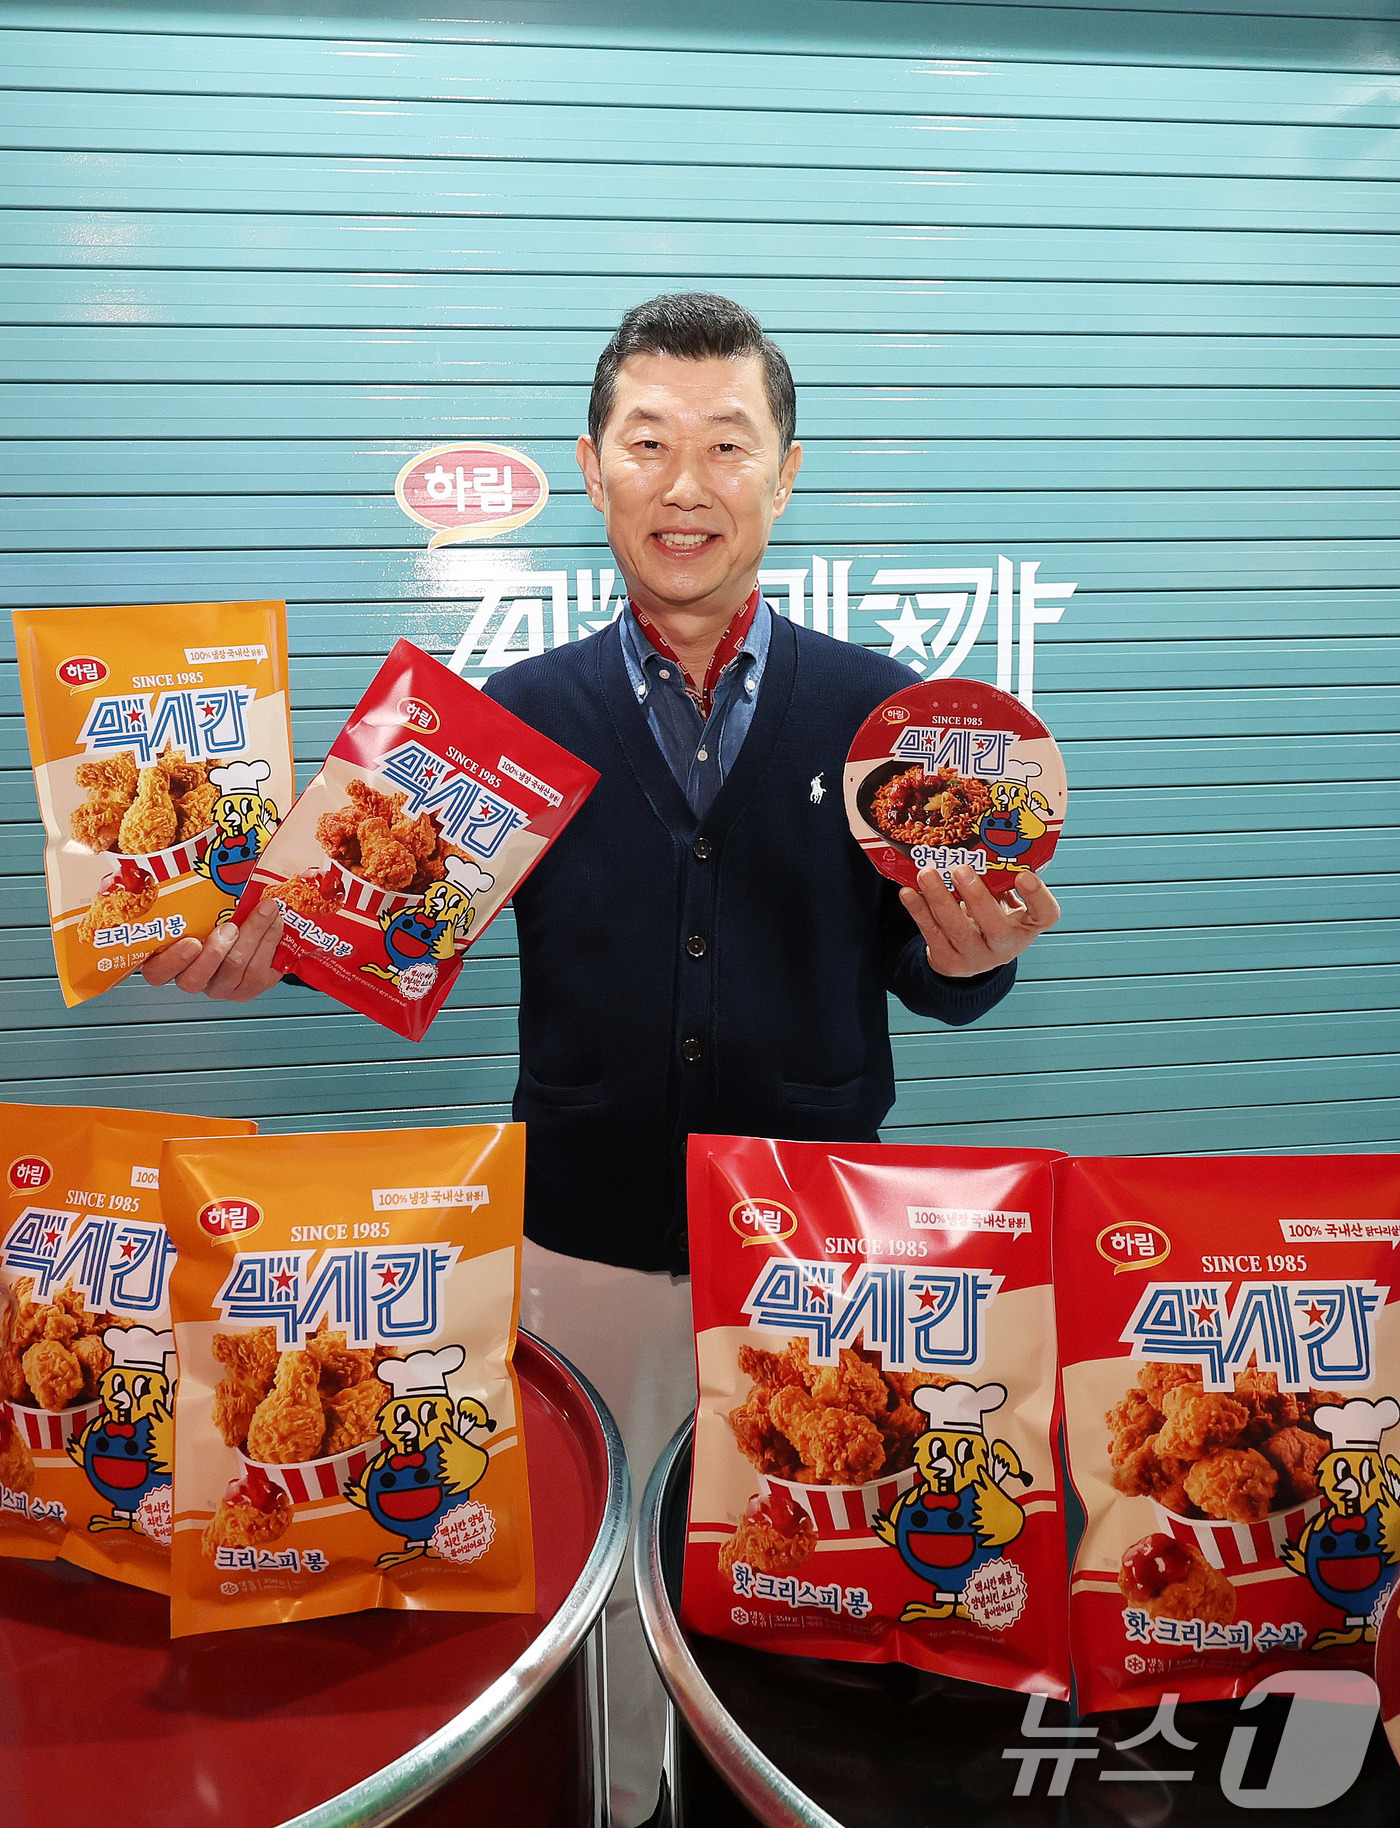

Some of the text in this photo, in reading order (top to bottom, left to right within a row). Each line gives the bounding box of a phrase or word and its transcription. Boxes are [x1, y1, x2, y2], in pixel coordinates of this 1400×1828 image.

[424, 465, 513, 513] 하림
[190, 651, 211, 661] 100%
[227, 647, 250, 658] 국내산
[66, 663, 99, 681] 하림
[132, 672, 204, 689] SINCE 1985
[86, 688, 250, 762] 맥시칸
[406, 702, 433, 729] 하림
[887, 710, 904, 720] 하림
[932, 715, 983, 726] SINCE 1985
[896, 730, 1014, 775] 맥시칸
[445, 746, 503, 788] SINCE 1985
[501, 761, 519, 776] 100%
[381, 745, 524, 859] 맥시칸
[913, 847, 984, 872] 양념치킨
[95, 916, 185, 946] 크리스피 봉
[286, 911, 337, 951] 크리스피
[335, 943, 352, 958] 봉
[16, 1163, 45, 1185] 하림
[66, 1190, 141, 1213] SINCE 1985
[378, 1193, 408, 1206] 100%
[409, 1192, 429, 1205] 냉장
[431, 1189, 464, 1203] 국내산
[207, 1207, 248, 1229] 하림
[741, 1207, 782, 1232] 하림
[914, 1212, 1026, 1229] 100% 냉장 국내산 닭봉!
[1288, 1224, 1323, 1237] 100%
[1324, 1222, 1363, 1238] 국내산
[290, 1221, 391, 1243] SINCE 1985
[1110, 1232, 1155, 1256] 하림
[825, 1237, 928, 1258] SINCE 1985
[5, 1212, 177, 1311] 맥시칸
[1202, 1255, 1307, 1273] SINCE 1985
[222, 1247, 452, 1343] 맥시칸
[752, 1264, 993, 1366] 맥시칸
[1133, 1284, 1379, 1384] 맥시칸
[440, 1510, 484, 1538] 맥시칸 양념
[443, 1524, 487, 1549] 치킨 소스가
[217, 1549, 327, 1572] 크리스피 봉
[734, 1564, 869, 1616] 핫 크리스피 봉
[974, 1571, 1013, 1594] 맥시칸 매콤
[971, 1584, 1021, 1610] 양념치킨 소스가
[1126, 1610, 1151, 1641] 핫
[1156, 1619, 1249, 1651] 크리스피
